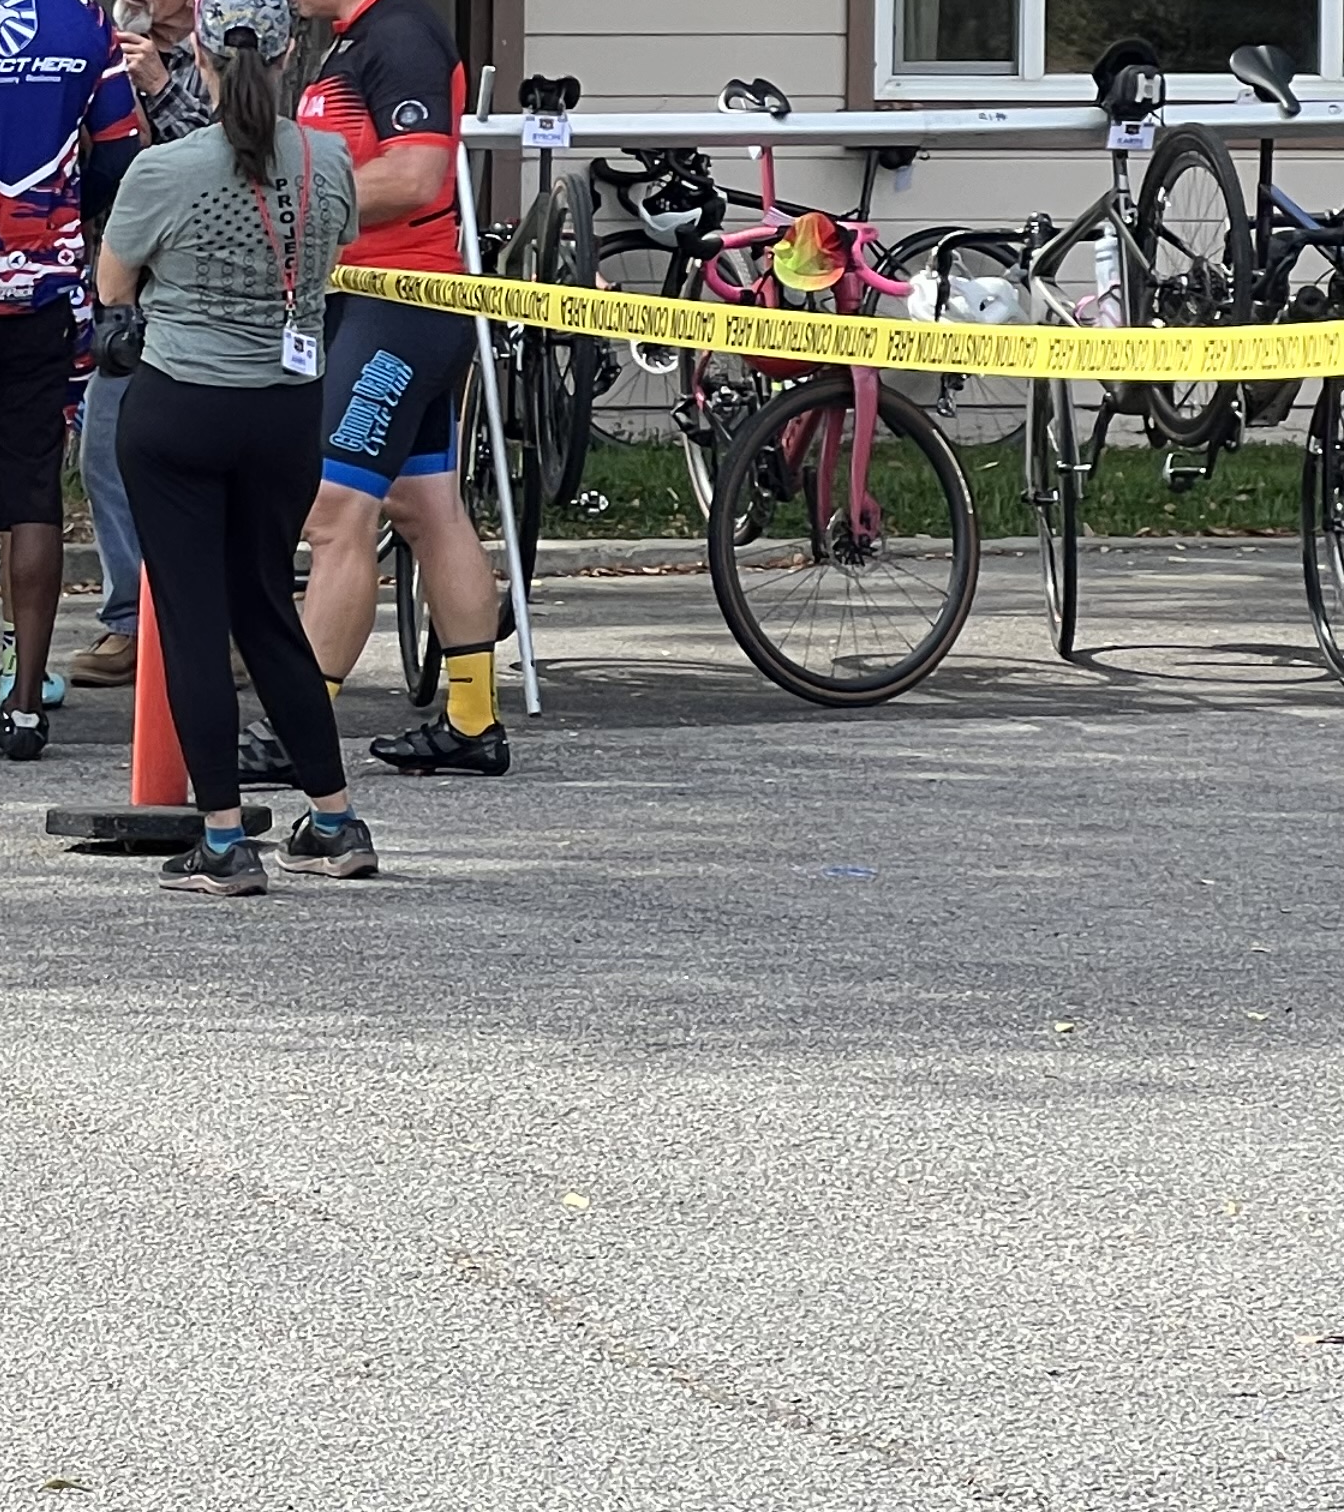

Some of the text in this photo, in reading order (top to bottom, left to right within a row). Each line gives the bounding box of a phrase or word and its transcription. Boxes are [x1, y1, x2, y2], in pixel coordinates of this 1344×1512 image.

[32, 56, 88, 73] HERO
[395, 274, 551, 322] CAUTION CONSTRUCTION AREA
[560, 294, 716, 343] CAUTION CONSTRUCTION AREA
[725, 314, 878, 359] CAUTION CONSTRUCTION AREA
[886, 329, 1039, 369] CAUTION CONSTRUCTION AREA
[1153, 339, 1193, 372] CAUTION
[352, 349, 409, 402] Valley
